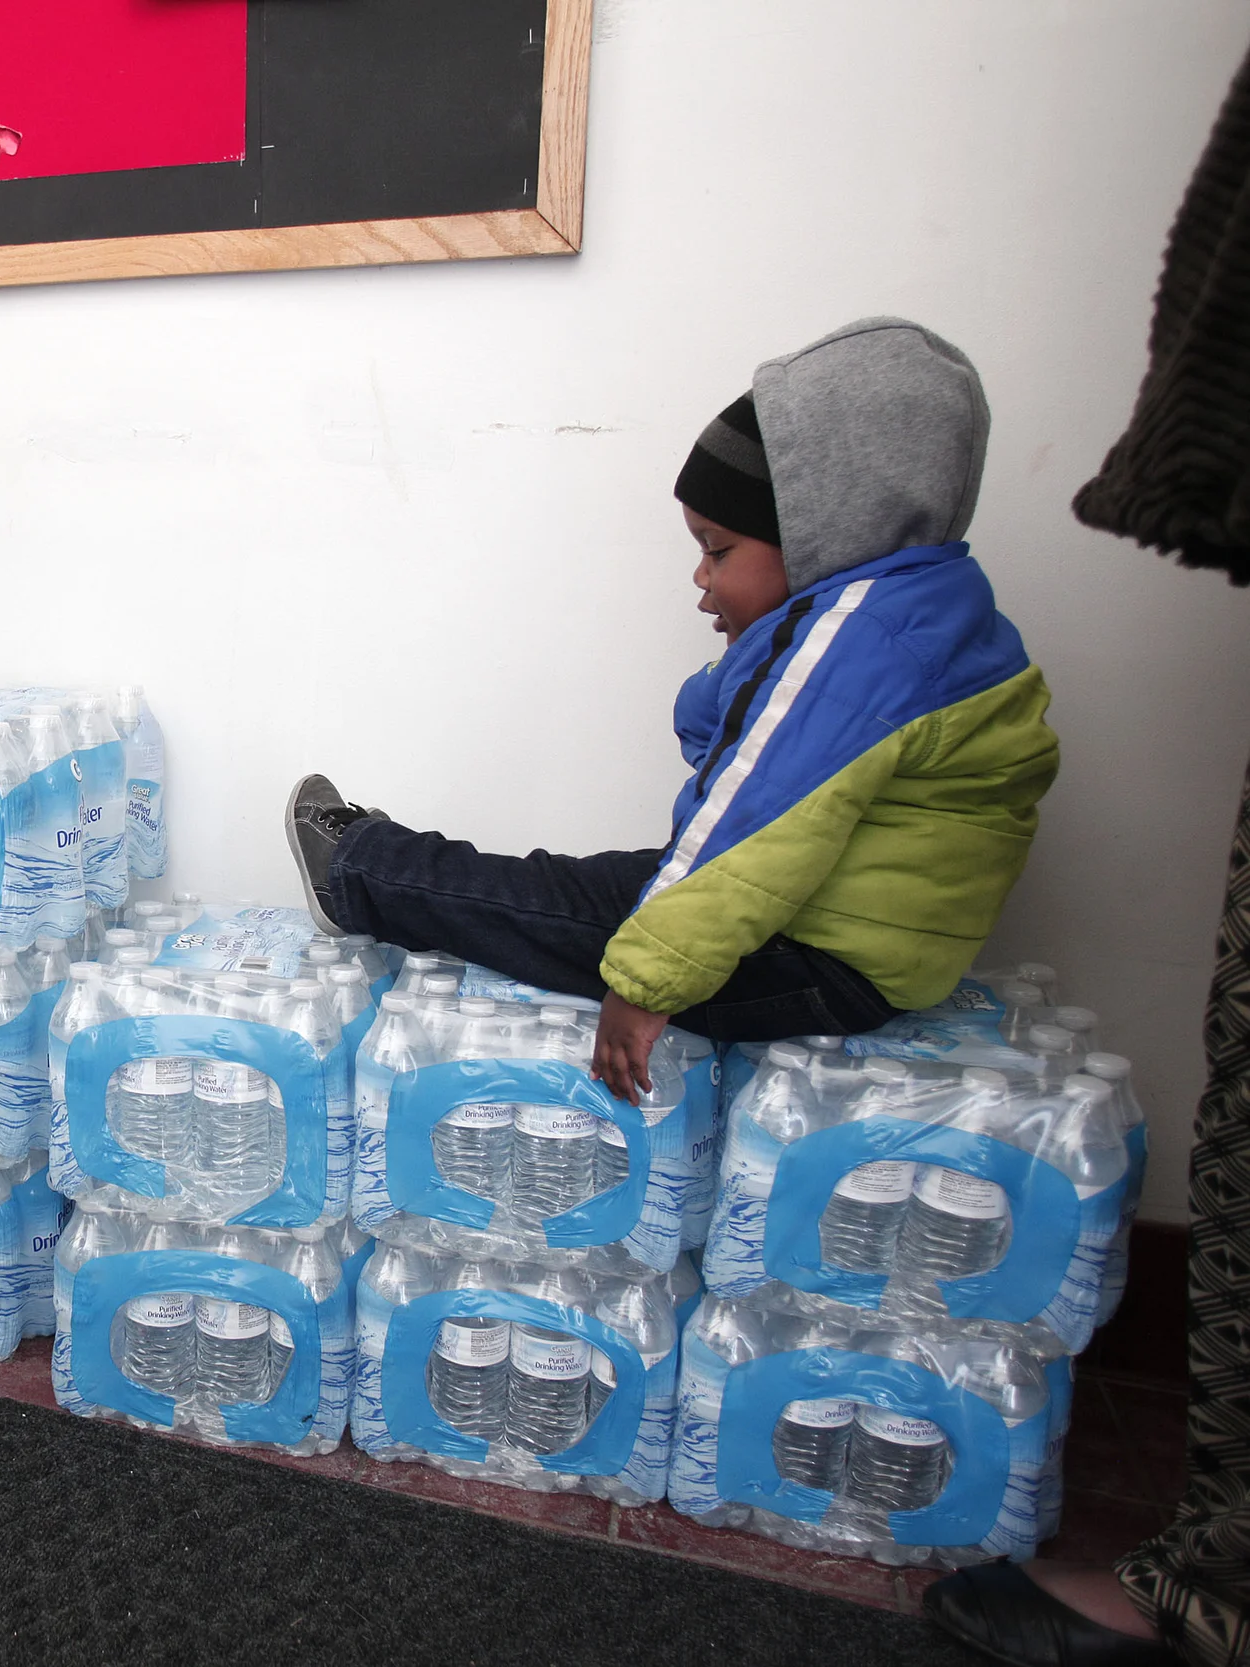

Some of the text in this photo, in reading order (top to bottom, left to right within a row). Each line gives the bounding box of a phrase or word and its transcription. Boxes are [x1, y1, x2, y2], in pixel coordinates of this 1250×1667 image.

[128, 799, 151, 817] Purified
[141, 812, 158, 831] Water
[210, 1086, 228, 1094] Water
[465, 1109, 494, 1120] Drinking
[565, 1113, 591, 1122] Purified
[552, 1120, 582, 1131] Drinking
[158, 1304, 184, 1313] Purified
[147, 1311, 175, 1320] Drinking
[548, 1356, 576, 1366] Purified
[535, 1361, 565, 1373] Drinking
[902, 1420, 933, 1430] Purified
[886, 1423, 921, 1438] Drinking
